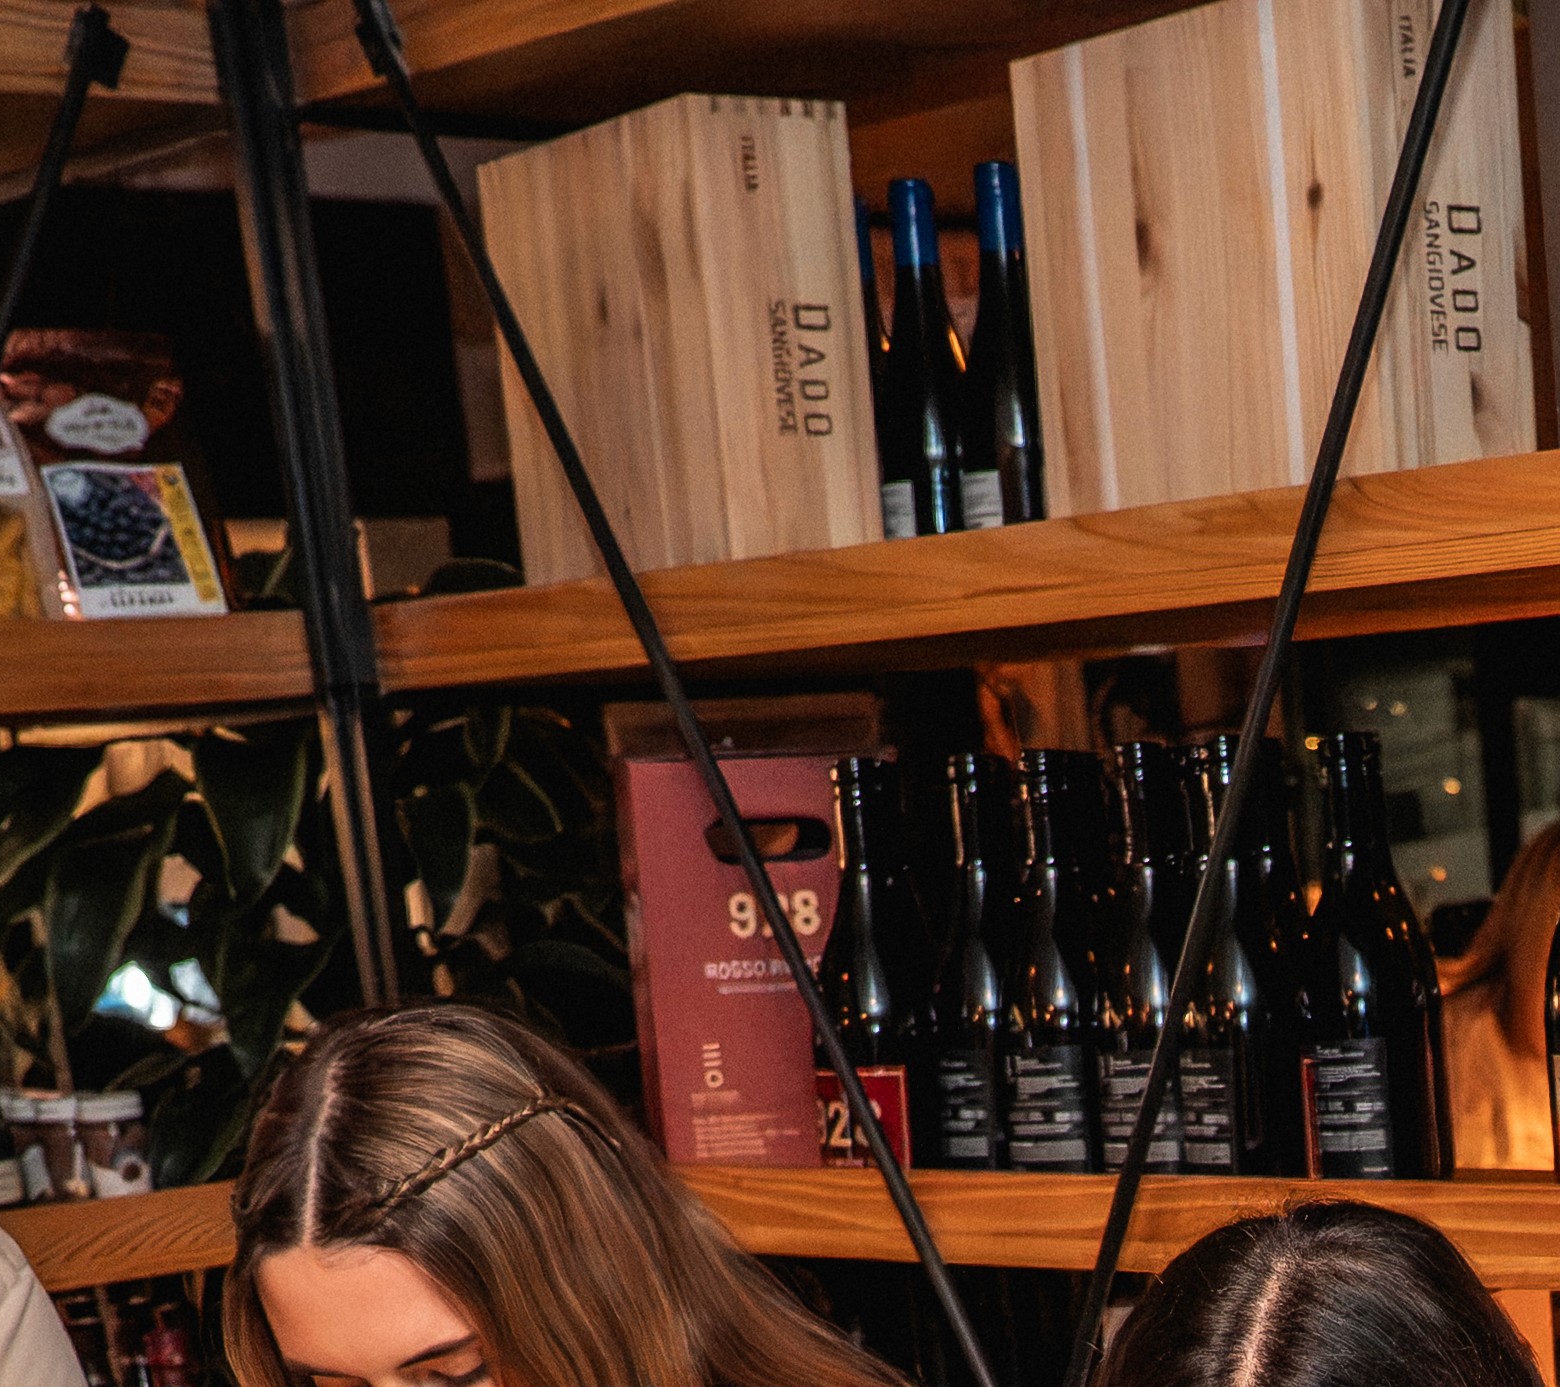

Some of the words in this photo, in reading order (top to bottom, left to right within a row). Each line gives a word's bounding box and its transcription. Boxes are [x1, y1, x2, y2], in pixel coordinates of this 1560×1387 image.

[1424, 200, 1449, 355] SANGIOVESE
[1446, 203, 1482, 352] DADO
[792, 304, 833, 436] DADO
